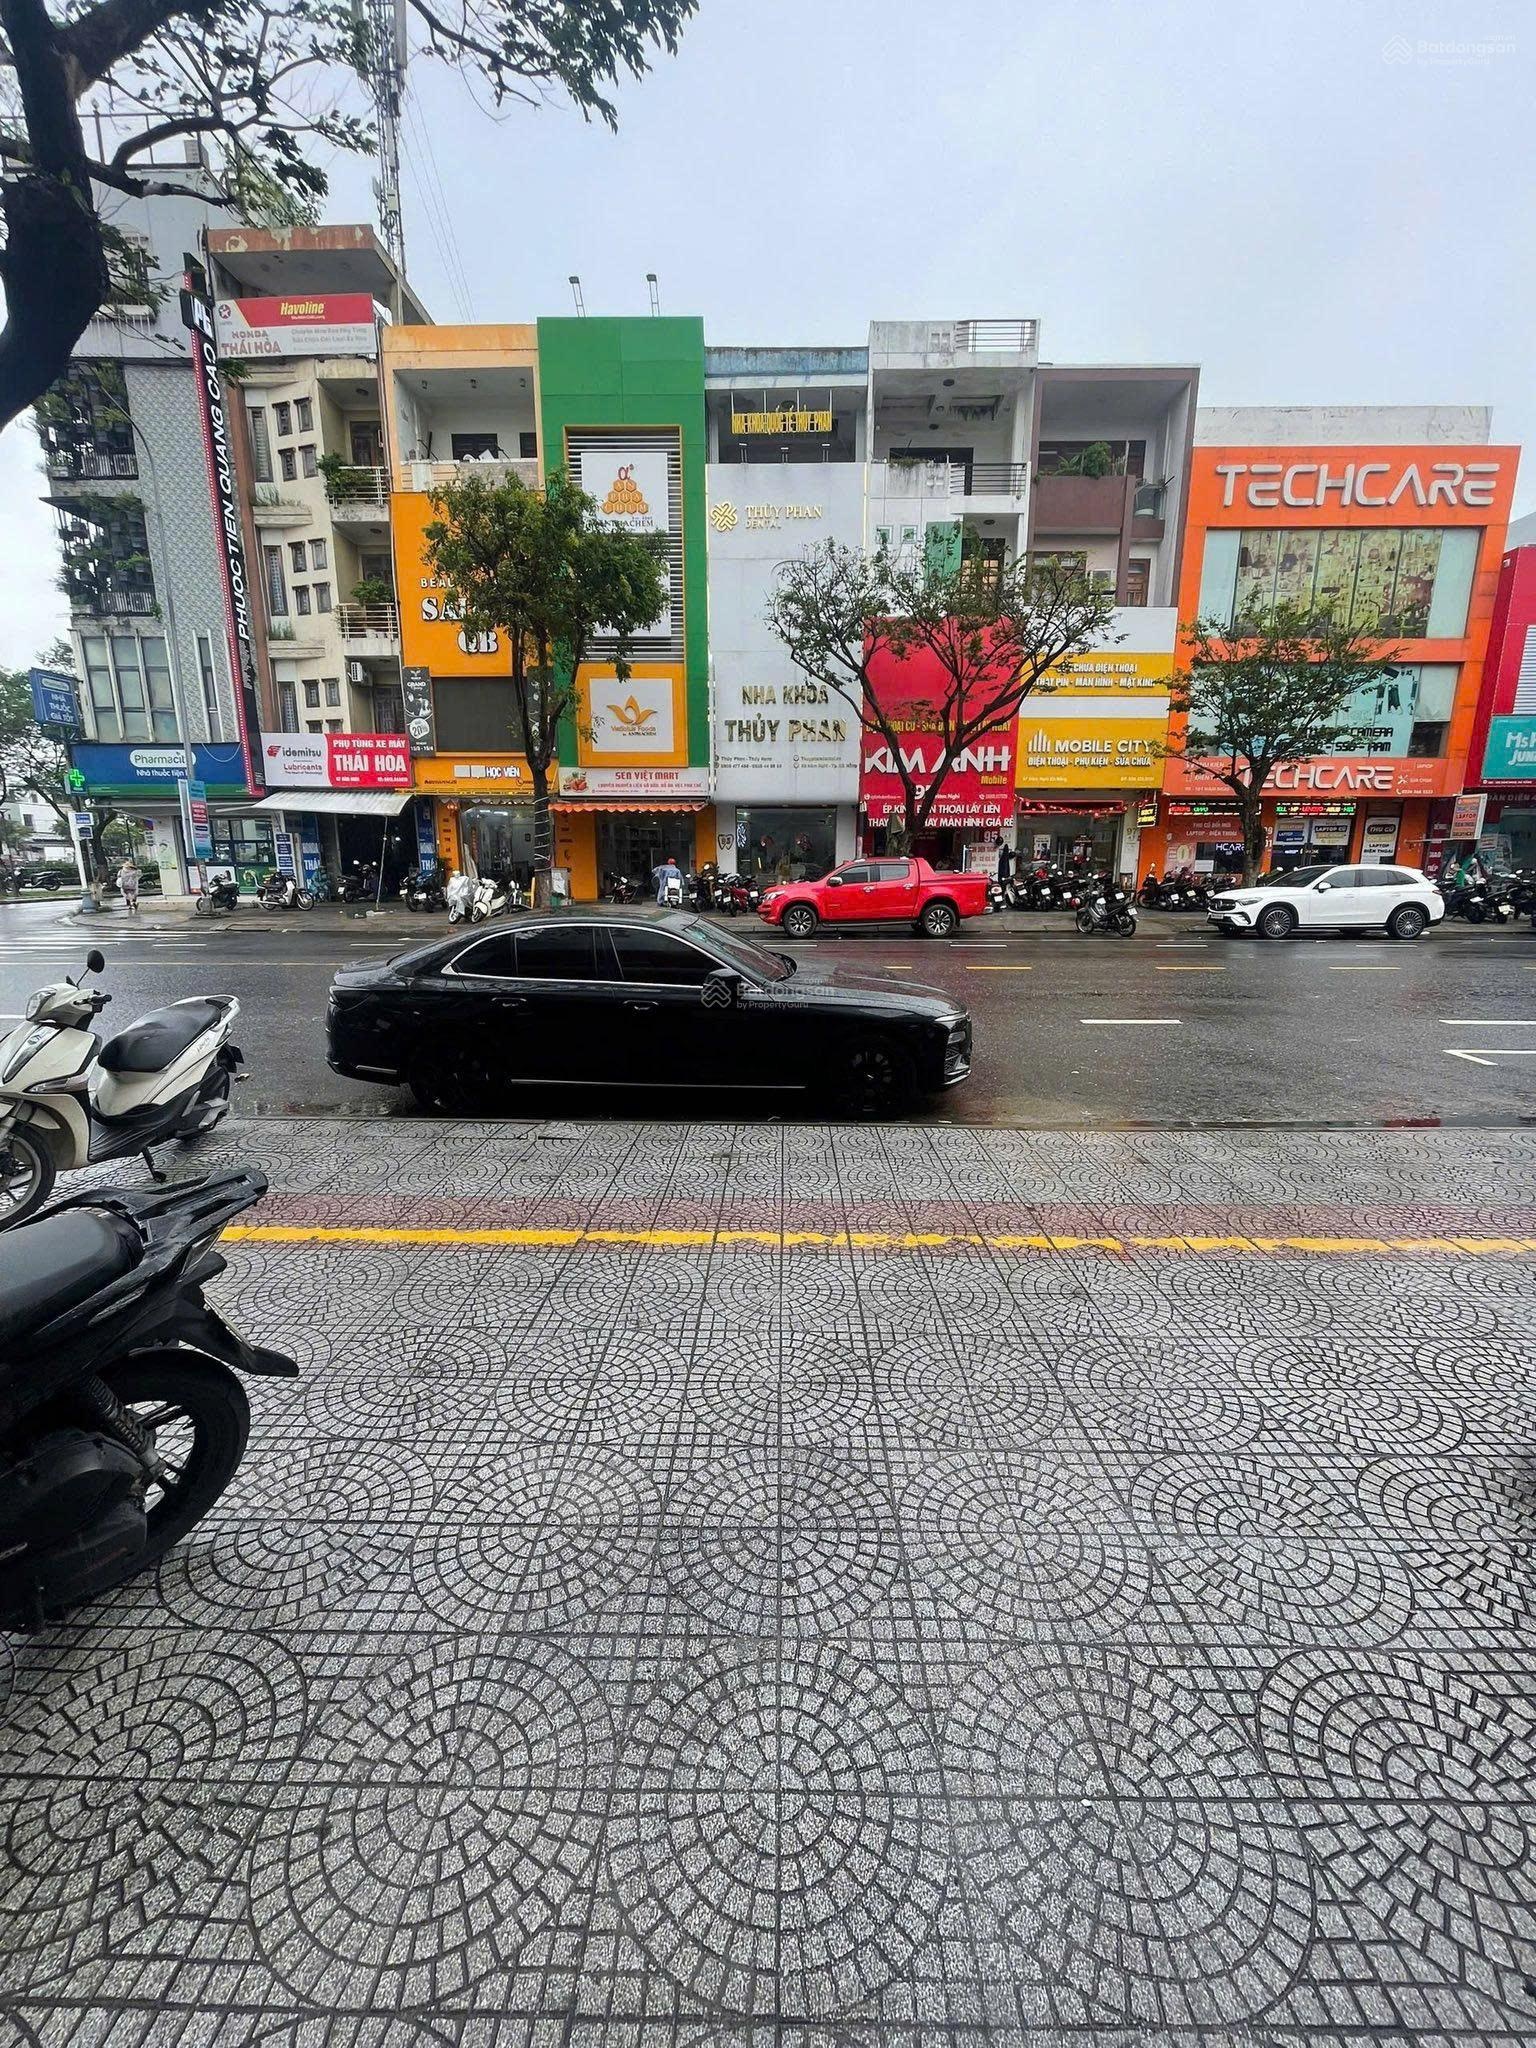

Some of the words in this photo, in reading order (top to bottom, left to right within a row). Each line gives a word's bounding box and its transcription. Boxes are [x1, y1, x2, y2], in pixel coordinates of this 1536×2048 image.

[280, 301, 325, 316] Havoline
[231, 329, 269, 339] HONDA
[222, 339, 252, 356] THÁI
[255, 338, 282, 355] HÒA
[203, 342, 221, 401] CAO
[211, 405, 232, 495] QUANG
[1215, 462, 1500, 507] TECHCARE
[785, 505, 824, 519] PHAN
[745, 520, 782, 529] DENTAL
[742, 685, 776, 705] NHA
[783, 684, 829, 705] KHOA
[724, 713, 781, 743] THỦY
[788, 719, 847, 743] PHAN
[1350, 727, 1394, 737] CAMERA
[333, 739, 349, 750] PHỤ
[351, 737, 374, 748] TÙNG
[375, 740, 387, 748] XE
[389, 737, 406, 748] MÁY
[1055, 739, 1112, 753] MOBILE
[1117, 739, 1151, 753] CITY
[134, 751, 187, 765] Pharmacit
[282, 747, 322, 757] idemitsu
[333, 750, 369, 772] THÁI
[375, 752, 407, 772] HÒA
[136, 769, 151, 777] Nhà
[151, 769, 169, 777] thuốc
[486, 767, 502, 779] HỌC
[504, 764, 520, 778] VIỆN
[615, 772, 633, 780] SEN
[633, 769, 653, 781] VIỆT
[655, 771, 680, 780] MART
[981, 775, 1007, 785] Mobile
[939, 803, 964, 815] THOẠI
[966, 801, 982, 813] LẤY
[984, 801, 1001, 813] LIỀN
[868, 818, 889, 828] THAY
[939, 816, 962, 828] MÀN
[963, 815, 984, 828] HÌNH
[986, 815, 1002, 828] GIÁ
[1004, 815, 1014, 828] RẺ
